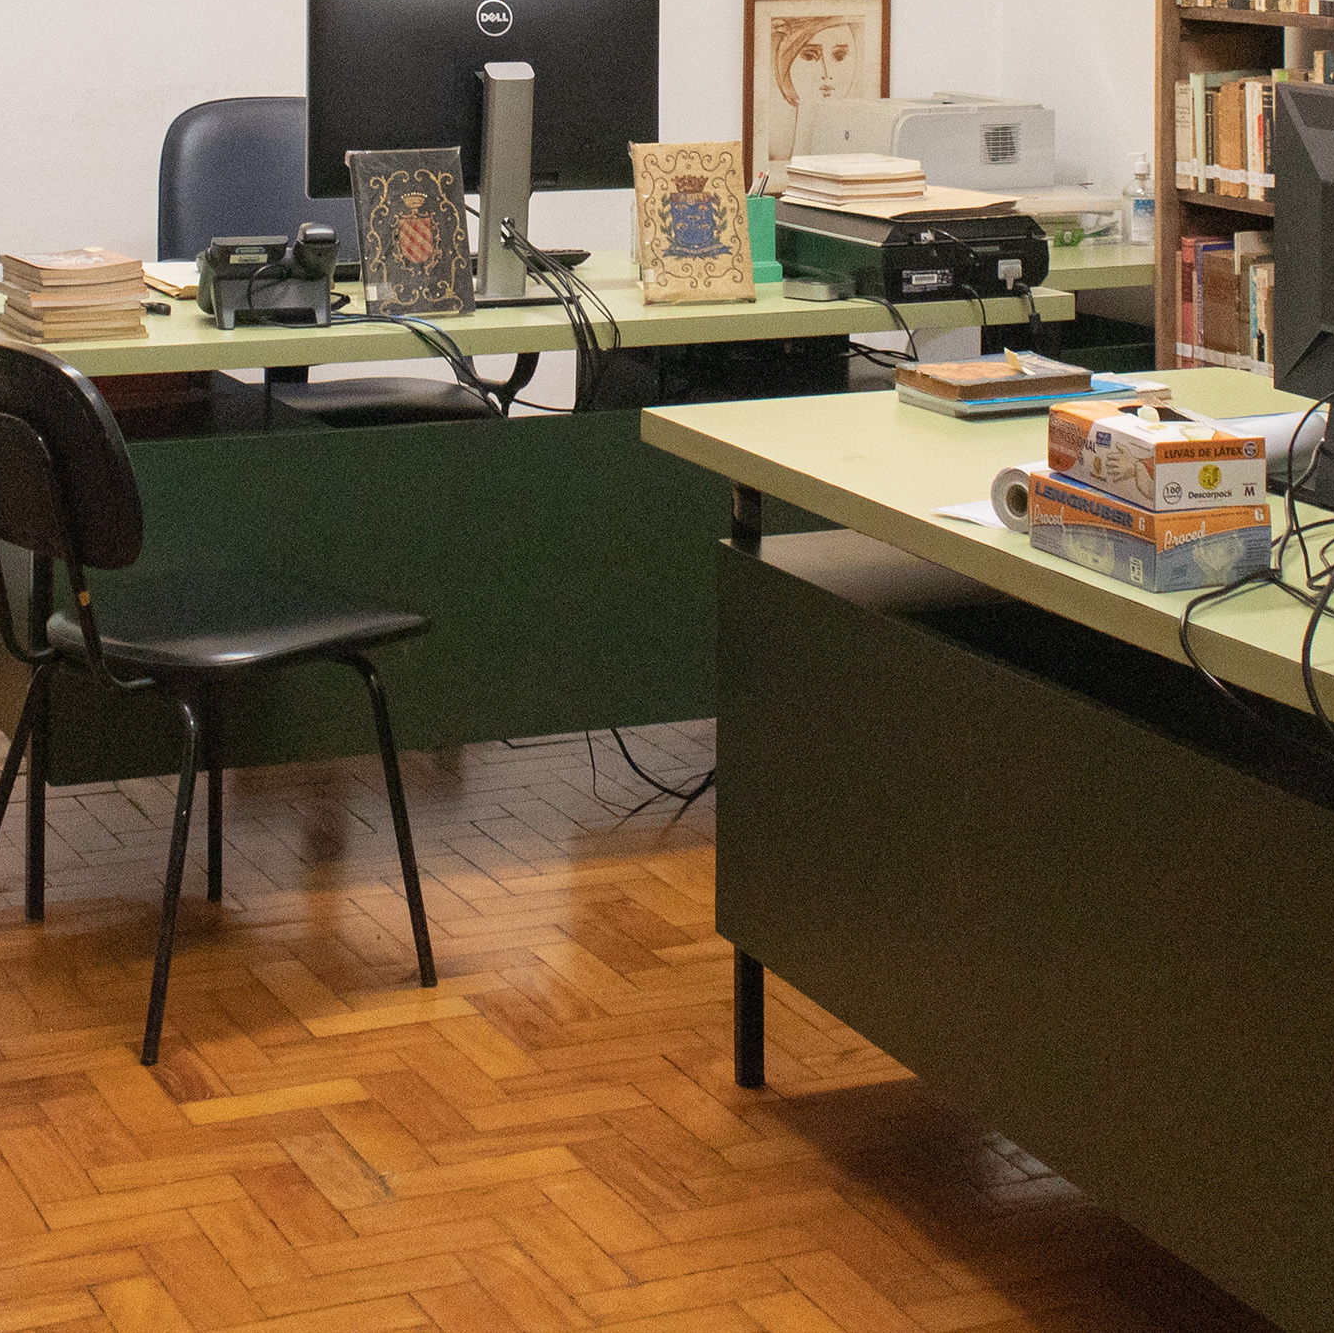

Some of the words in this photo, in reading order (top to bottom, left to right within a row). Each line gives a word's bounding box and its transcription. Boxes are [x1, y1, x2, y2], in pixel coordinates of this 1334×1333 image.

[480, 10, 509, 25] DELL
[1164, 447, 1195, 458] LUVAS
[1198, 446, 1212, 457] DE
[1188, 489, 1233, 500] Descarpack
[1244, 485, 1255, 496] M
